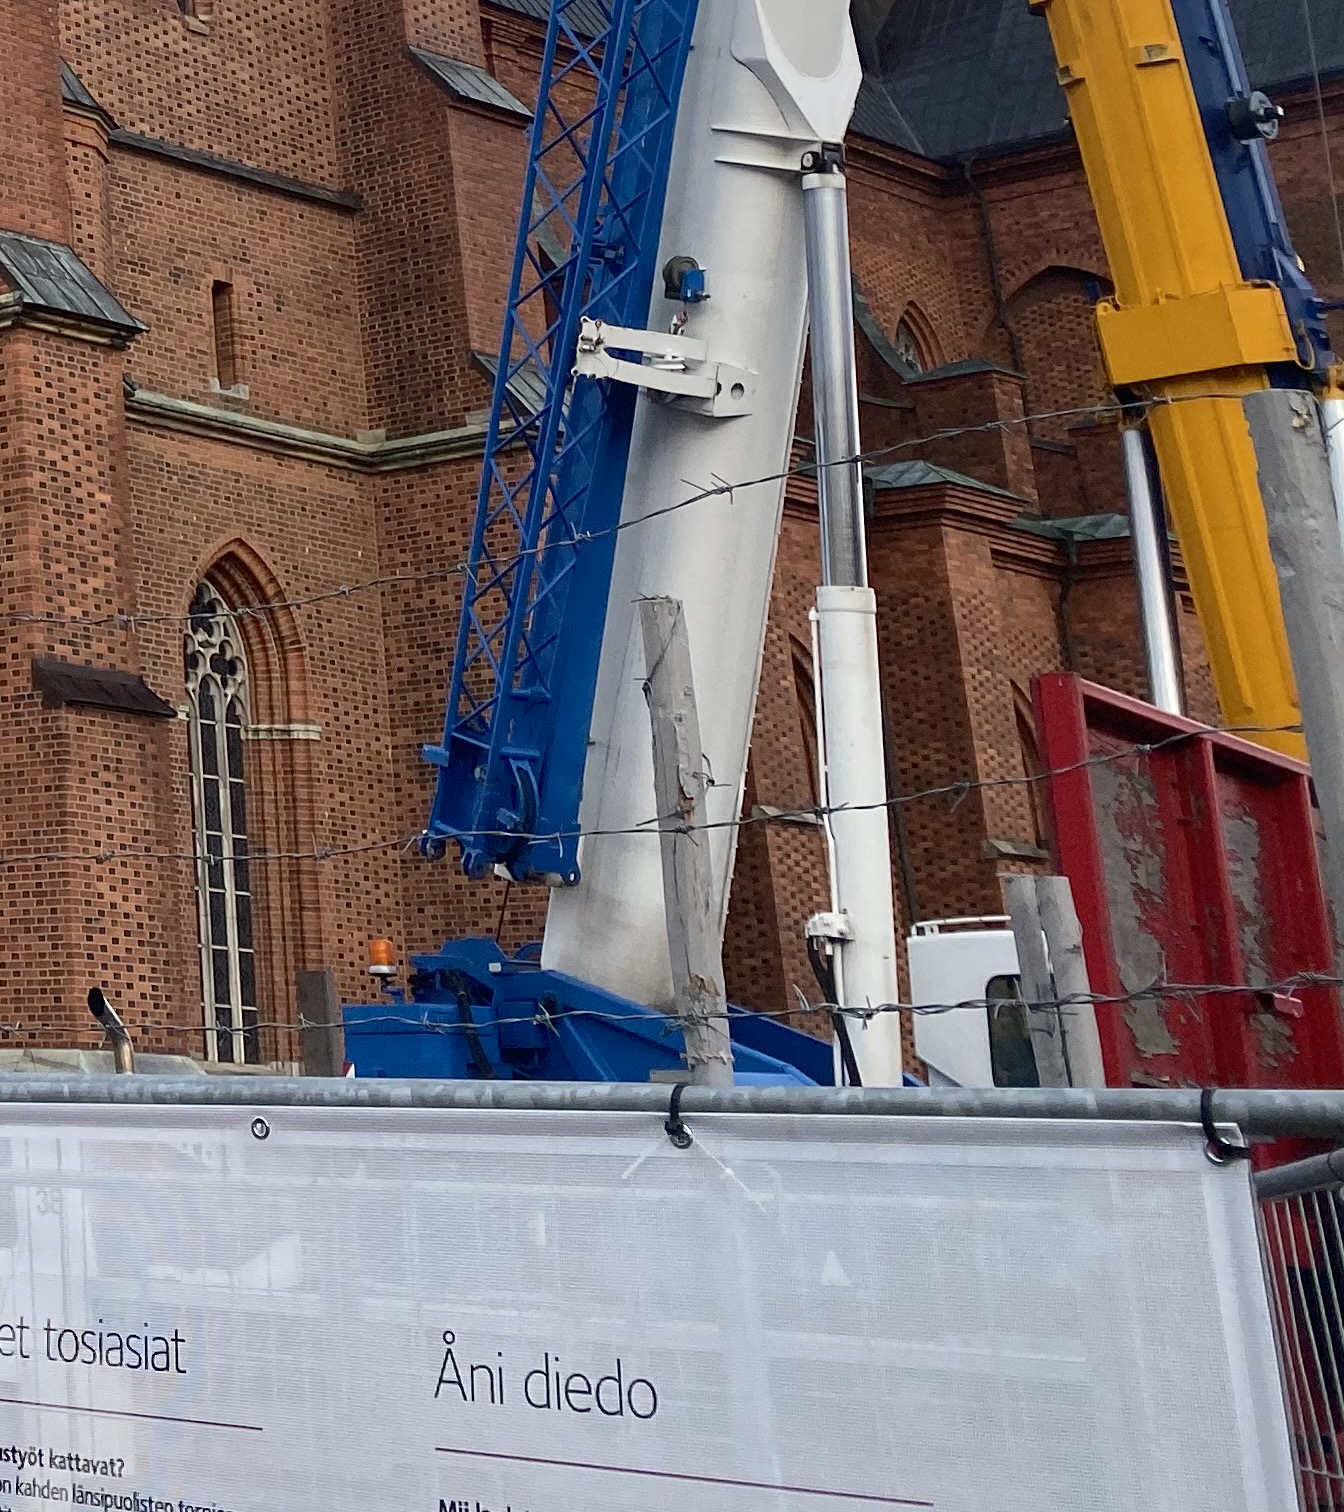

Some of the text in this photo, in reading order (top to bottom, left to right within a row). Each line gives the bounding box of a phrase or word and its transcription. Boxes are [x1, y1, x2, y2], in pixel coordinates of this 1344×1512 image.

[44, 1317, 187, 1374] tosiasiat
[434, 1330, 658, 1419] Åni diedo
[49, 1448, 125, 1478] kattavat?
[15, 1475, 68, 1502] kahden
[72, 1483, 174, 1512] länsipuolisten
